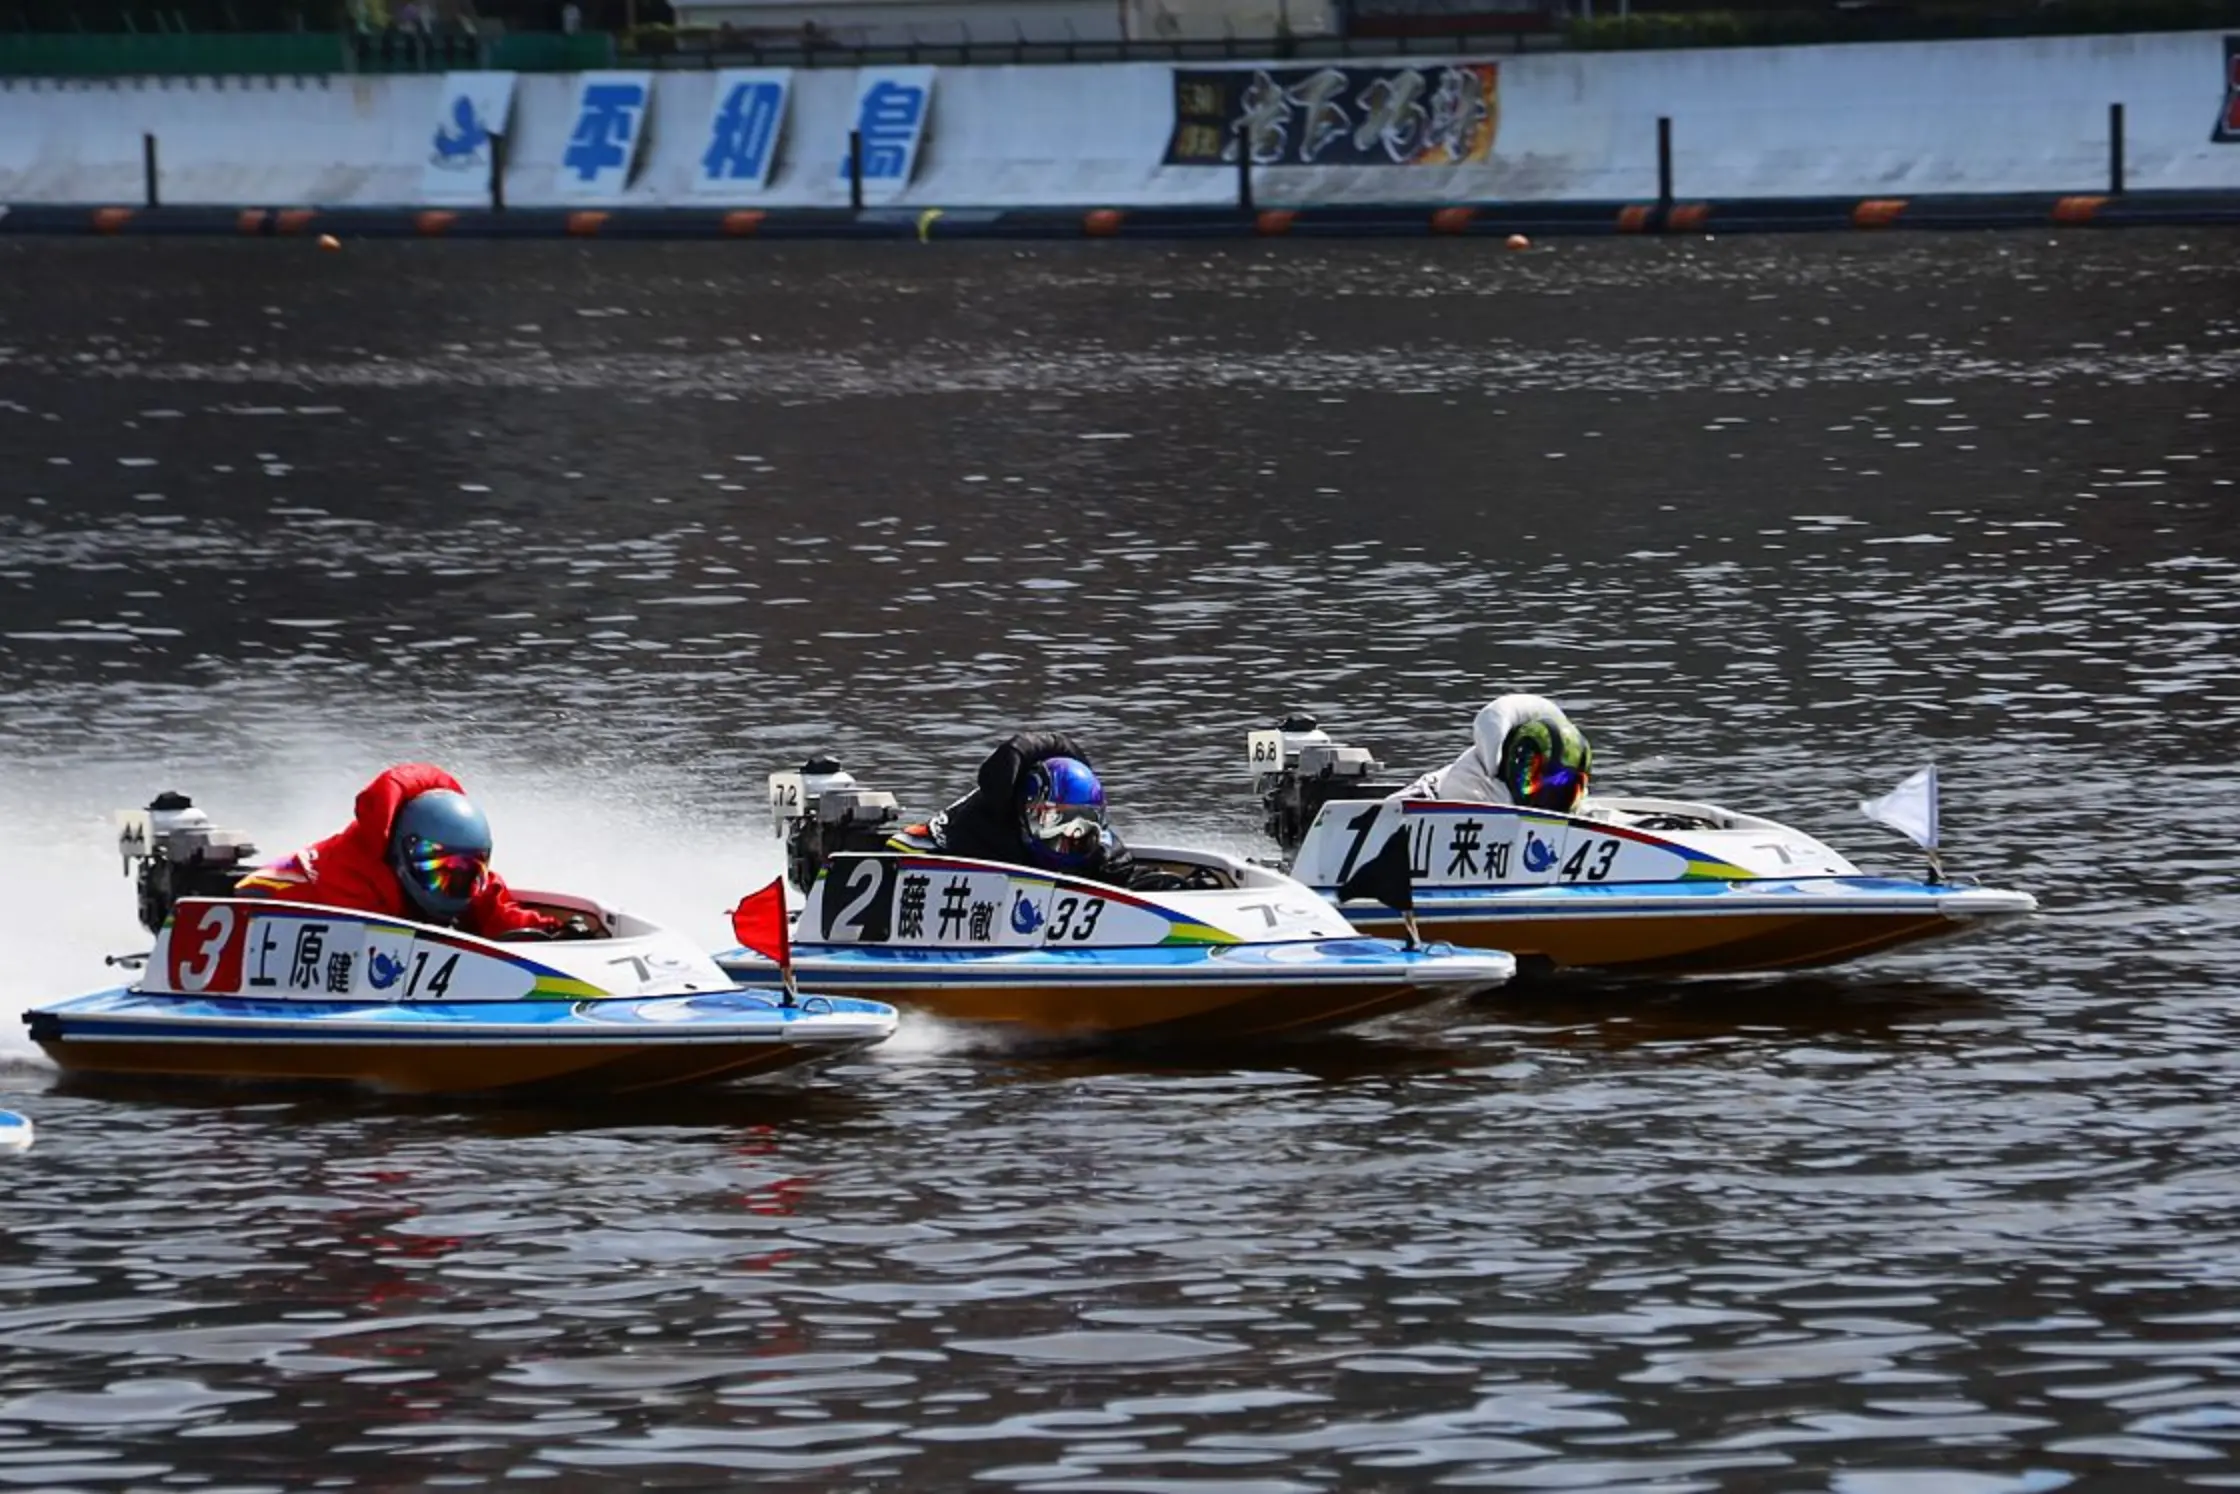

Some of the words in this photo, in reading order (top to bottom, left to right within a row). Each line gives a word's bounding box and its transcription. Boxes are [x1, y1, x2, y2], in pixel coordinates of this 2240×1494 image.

[1336, 804, 1383, 883] 1
[1563, 839, 1621, 881] 43
[829, 860, 884, 942] 2
[898, 874, 996, 943] 藤井徹
[1048, 898, 1105, 941] 33
[179, 906, 234, 992] 3
[250, 921, 354, 994] 上原健
[407, 952, 461, 998] 14
